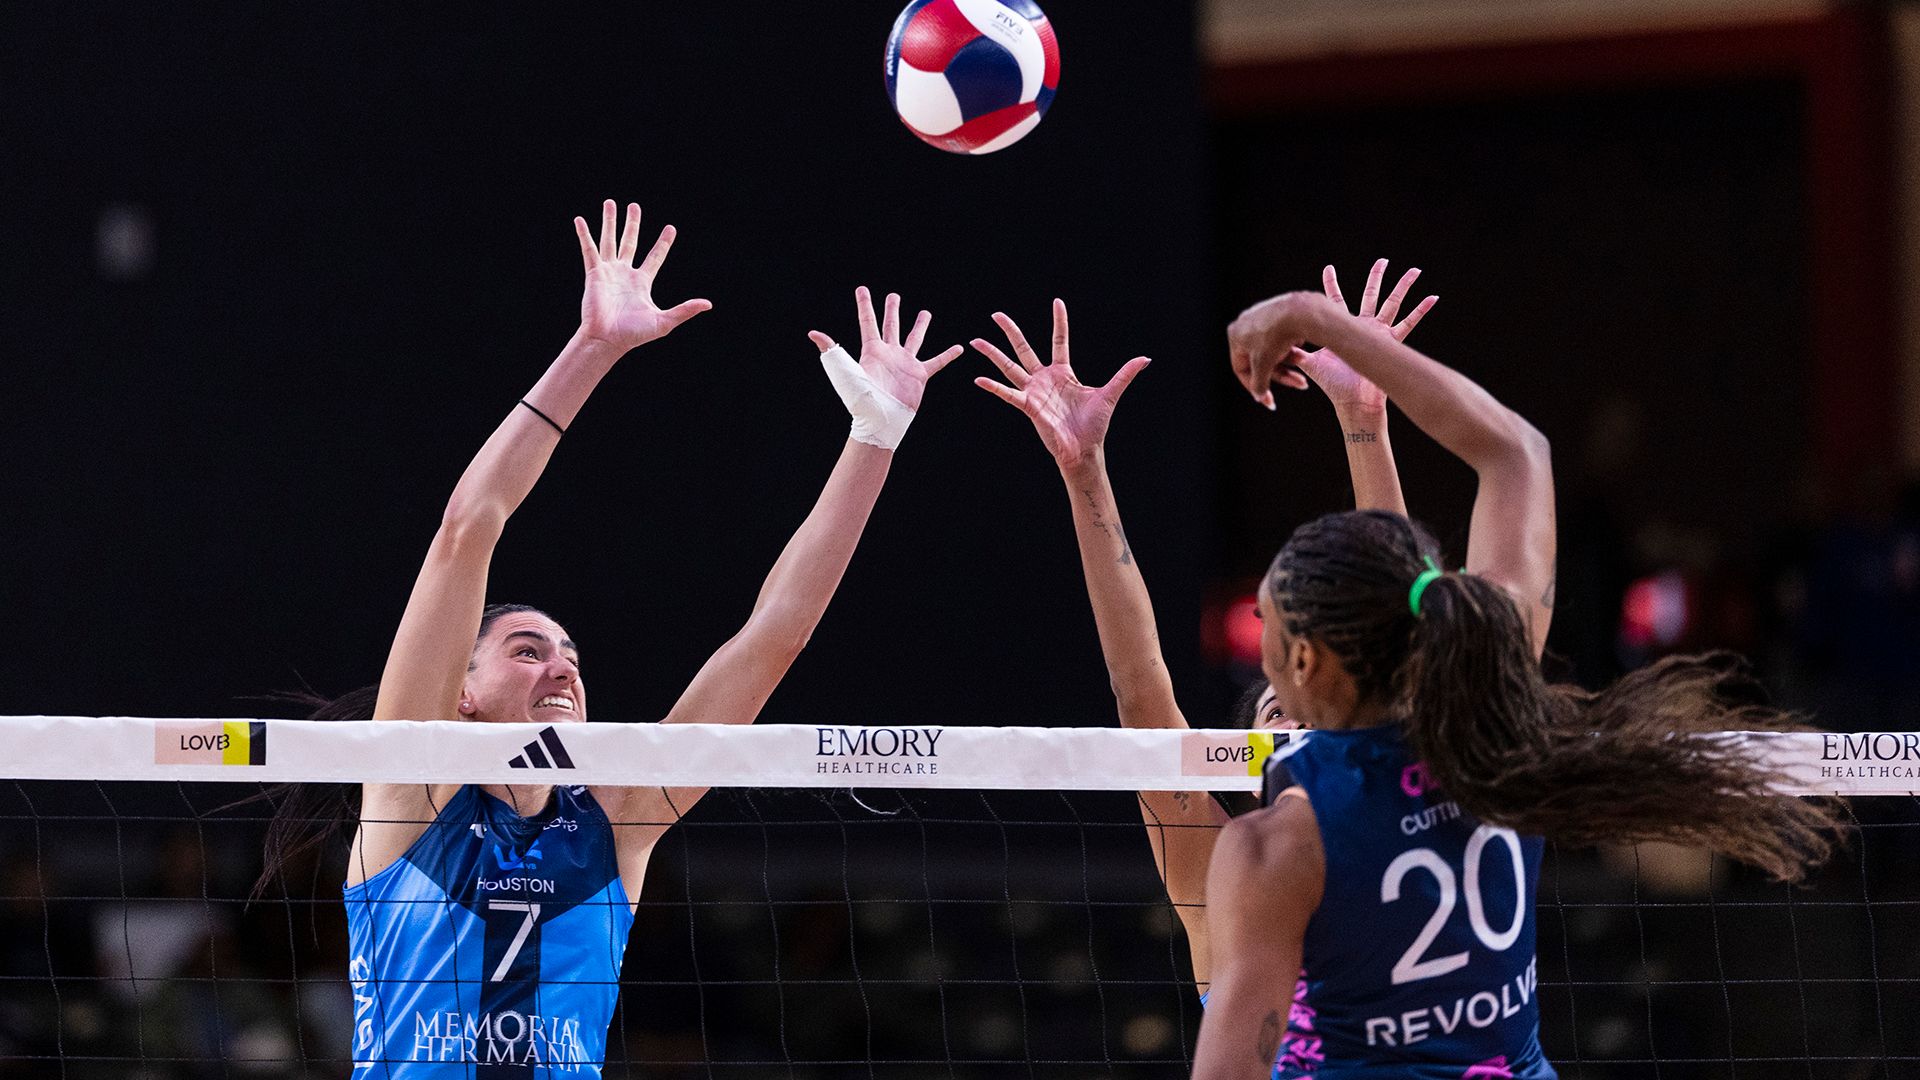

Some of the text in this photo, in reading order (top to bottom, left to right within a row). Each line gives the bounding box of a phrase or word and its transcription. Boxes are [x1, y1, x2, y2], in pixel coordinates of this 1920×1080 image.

[816, 728, 943, 757] EMORY
[1820, 733, 1920, 761] EMOR
[816, 762, 938, 775] HEALTHCARE
[476, 876, 555, 894] HOUSTON
[1381, 822, 1526, 986] 20
[488, 899, 542, 983] 7
[411, 1033, 582, 1074] HERMANN
